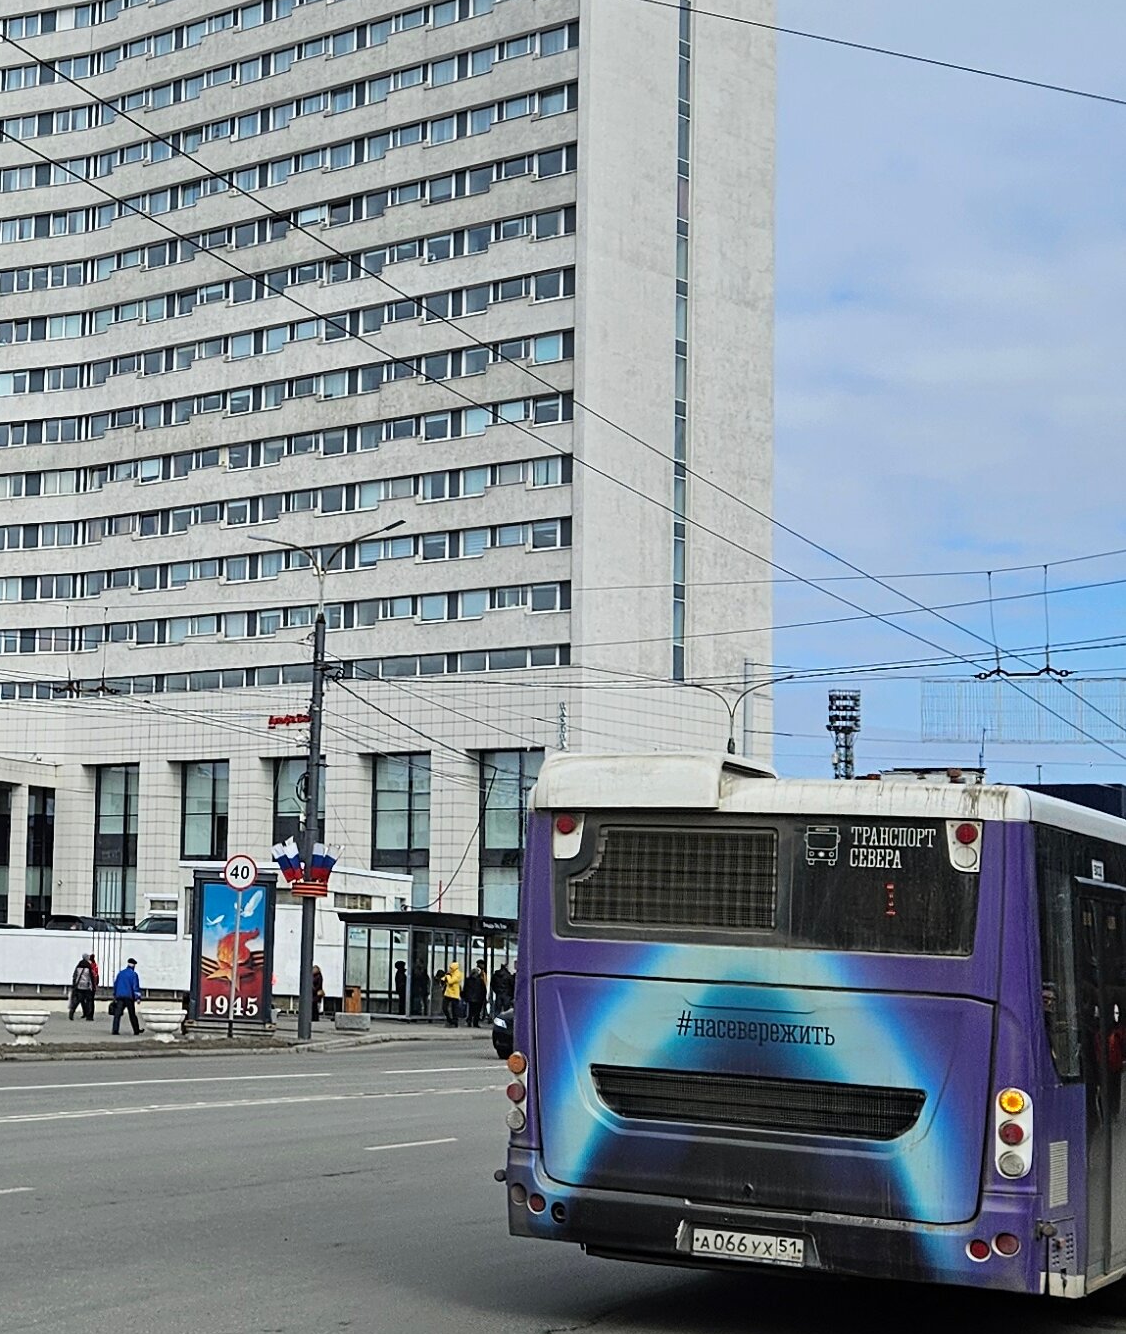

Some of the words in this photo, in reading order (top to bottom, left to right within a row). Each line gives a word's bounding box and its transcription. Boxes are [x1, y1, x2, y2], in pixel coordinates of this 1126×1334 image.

[850, 826, 937, 848] ТРАНСПОРТ
[849, 848, 903, 869] СЕВЕРА
[229, 864, 250, 879] 40
[203, 995, 259, 1017] 1945
[675, 1009, 836, 1046] #насевережить
[778, 1239, 797, 1254] 51
